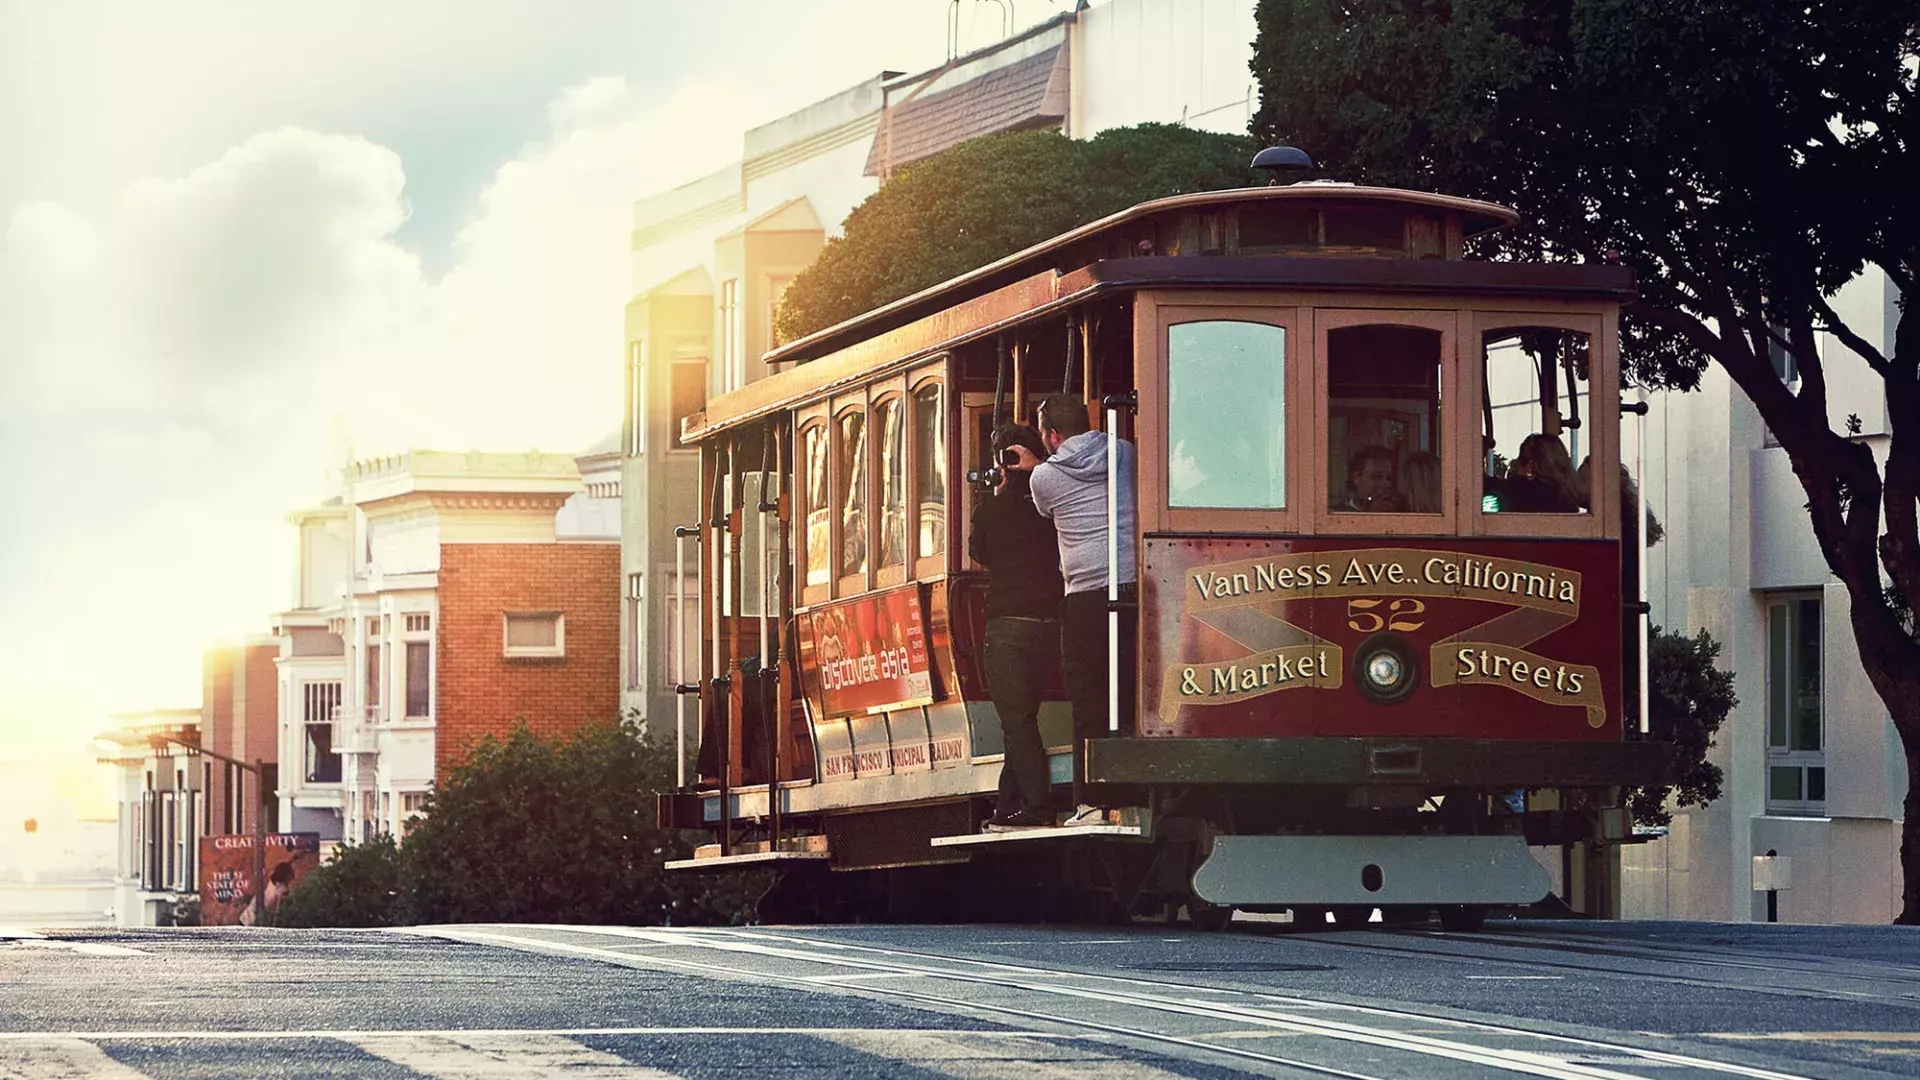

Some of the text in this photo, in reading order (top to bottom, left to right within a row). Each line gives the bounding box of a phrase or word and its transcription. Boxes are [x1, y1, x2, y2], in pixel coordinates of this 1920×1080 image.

[1194, 571, 1250, 600] Van
[1253, 562, 1331, 591] Ness
[1423, 557, 1575, 603] California
[1347, 598, 1426, 632] 52
[1181, 650, 1328, 695] & Market
[1457, 648, 1584, 693] Streets
[826, 757, 840, 776] SAN
[929, 740, 962, 762] RAILWAY
[215, 835, 299, 849] CREATIVITY
